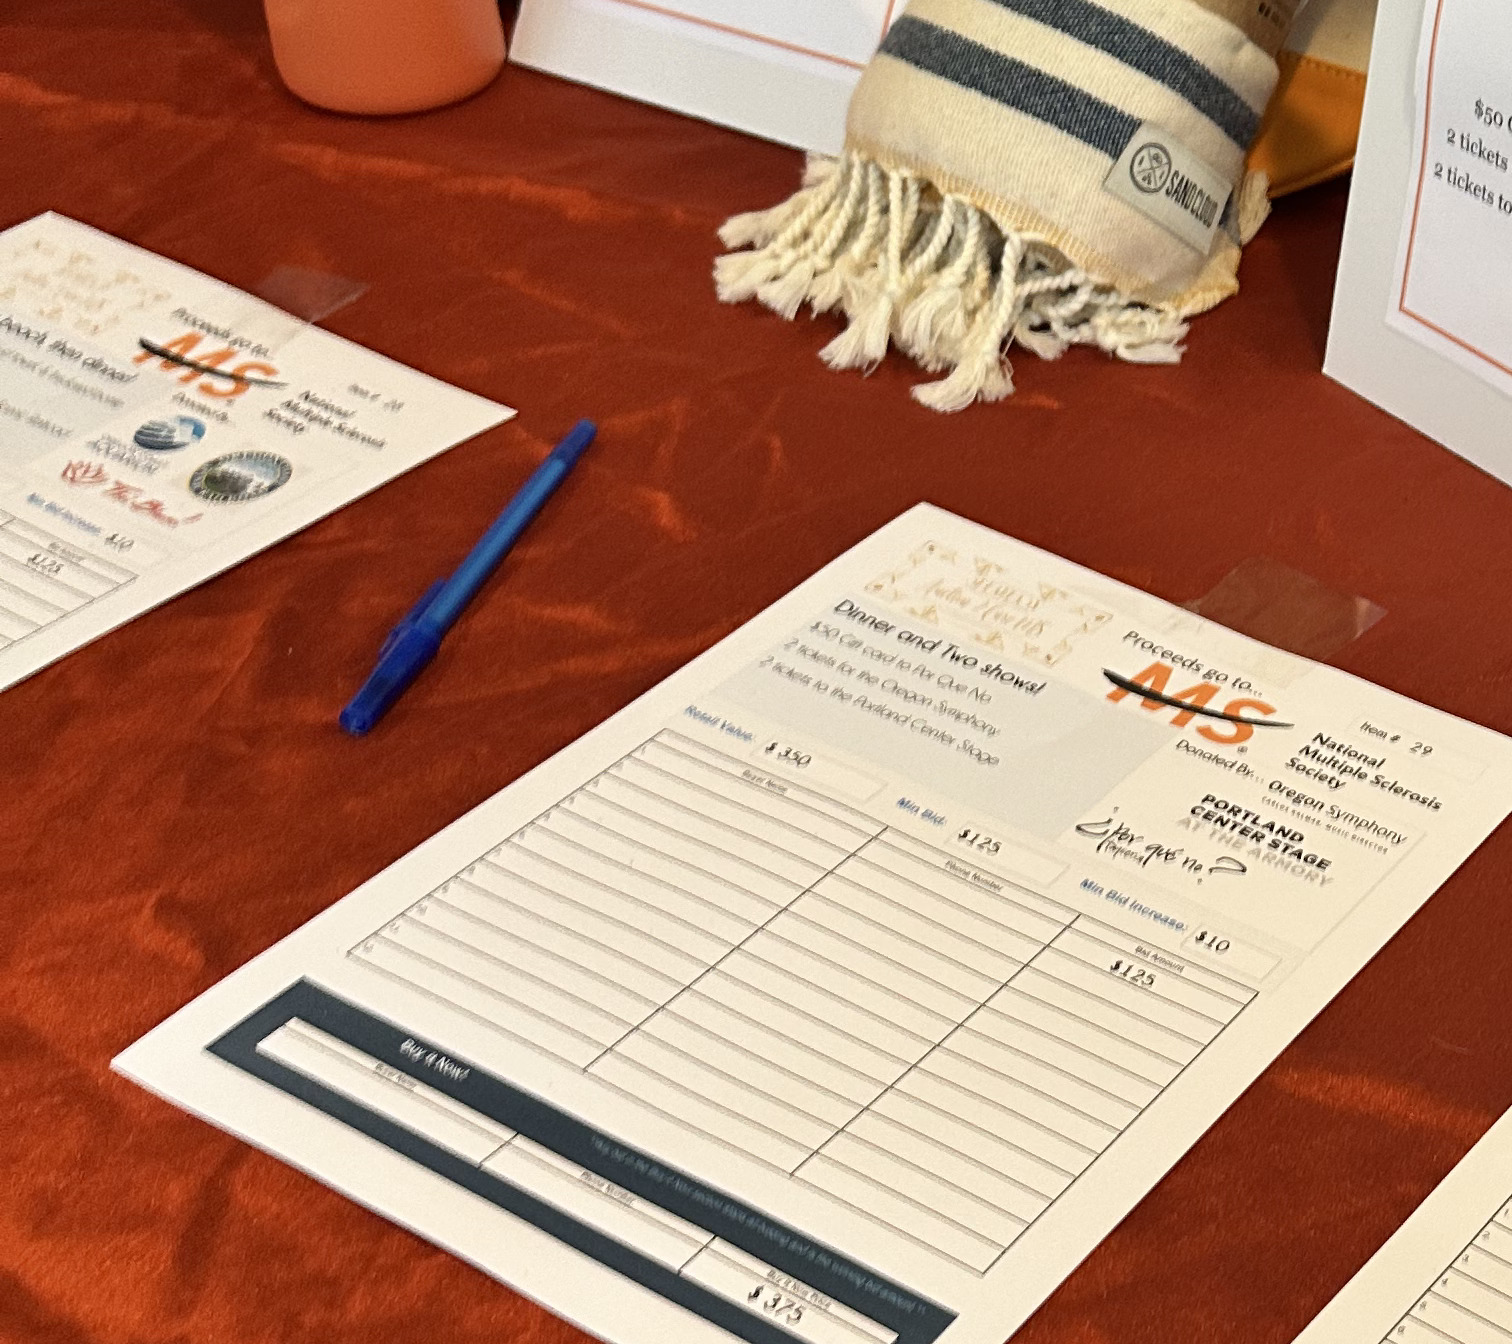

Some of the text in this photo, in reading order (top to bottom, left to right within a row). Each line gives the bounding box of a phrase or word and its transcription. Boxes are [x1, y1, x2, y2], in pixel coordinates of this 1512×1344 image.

[1474, 98, 1504, 128] $50
[1447, 128, 1456, 144] 2
[1460, 133, 1508, 171] tickets
[1165, 169, 1219, 229] SANDCLOUD
[1434, 162, 1444, 178] 2
[1447, 167, 1494, 205] tickets
[1498, 194, 1512, 215] to
[1106, 659, 1278, 747] MS
[1312, 732, 1387, 769] National
[1285, 757, 1347, 790] Society
[1298, 744, 1442, 810] Multiple Sclerosis
[958, 829, 1001, 853] $125
[1195, 931, 1230, 952] $10
[1110, 960, 1155, 986] $125
